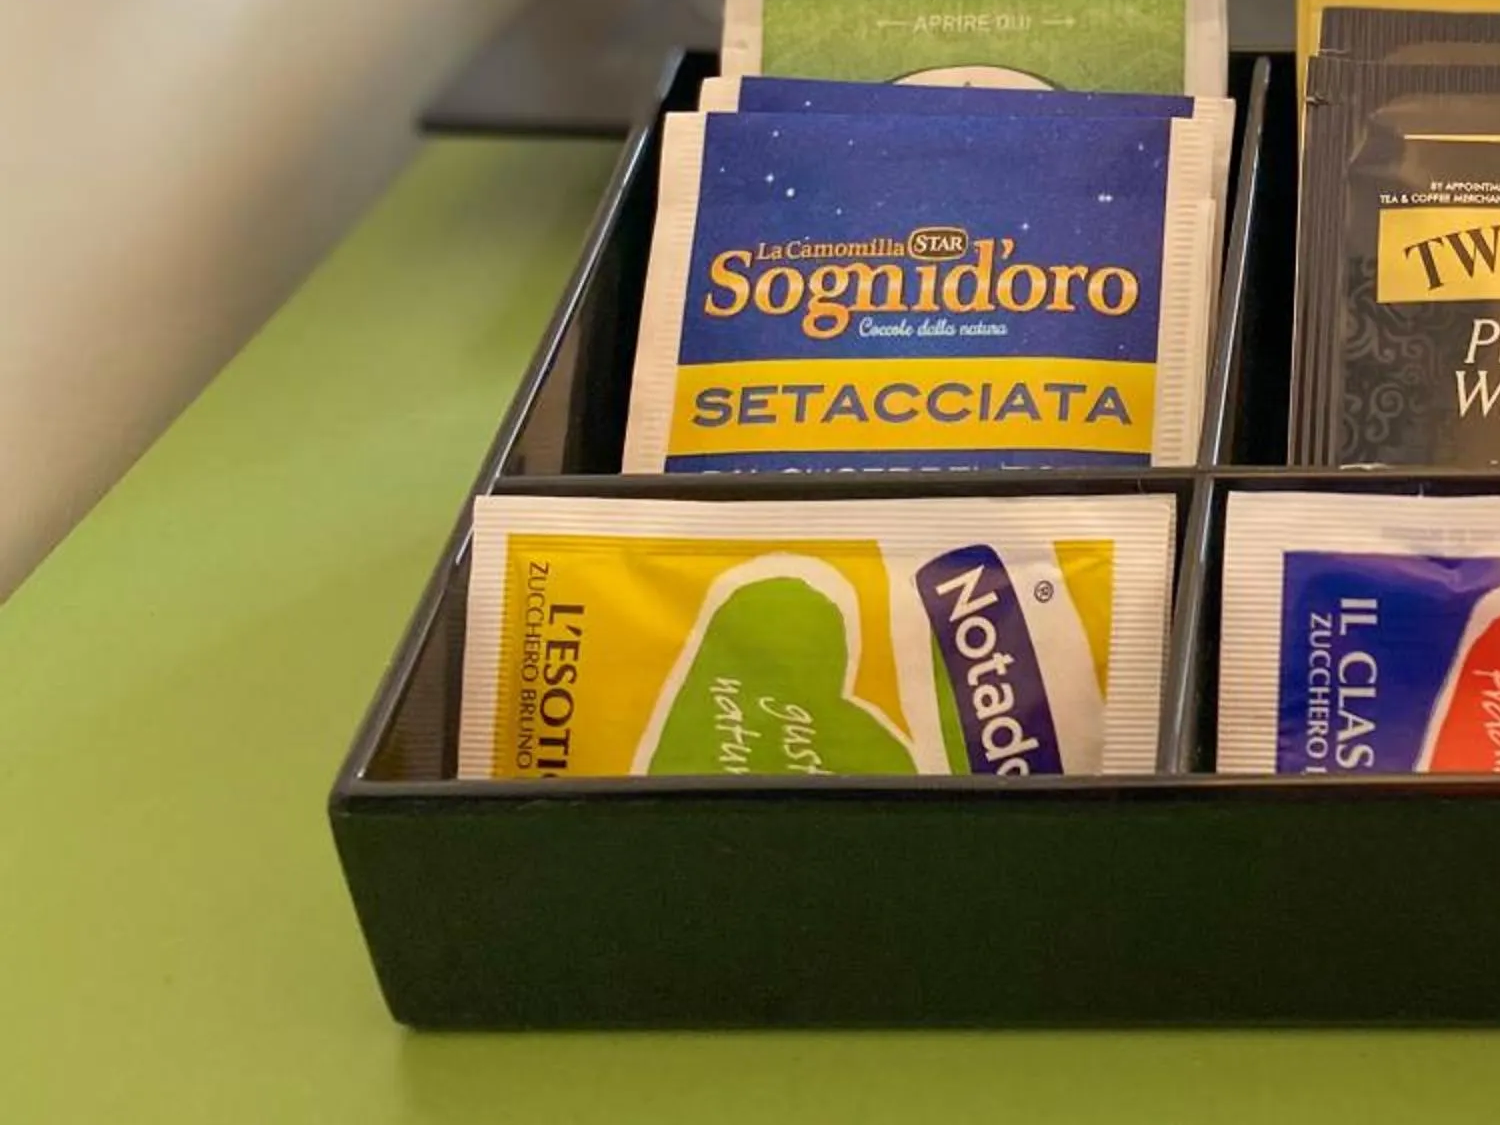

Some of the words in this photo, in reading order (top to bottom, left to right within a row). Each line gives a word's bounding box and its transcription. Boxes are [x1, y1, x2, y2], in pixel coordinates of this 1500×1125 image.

[912, 13, 991, 34] APRIRE
[1380, 194, 1398, 204] TEA
[1400, 194, 1408, 204] &
[1411, 193, 1451, 203] COFFEE
[914, 234, 963, 253] STAR
[692, 382, 1133, 428] SETACCIATA
[521, 562, 549, 682] ZUCCHERO
[1339, 598, 1378, 635] IL
[537, 604, 585, 777] L'ESOTI
[1305, 612, 1332, 759] ZUCCHERO
[1335, 651, 1378, 769] CLAS
[516, 689, 537, 769] BRUNO
